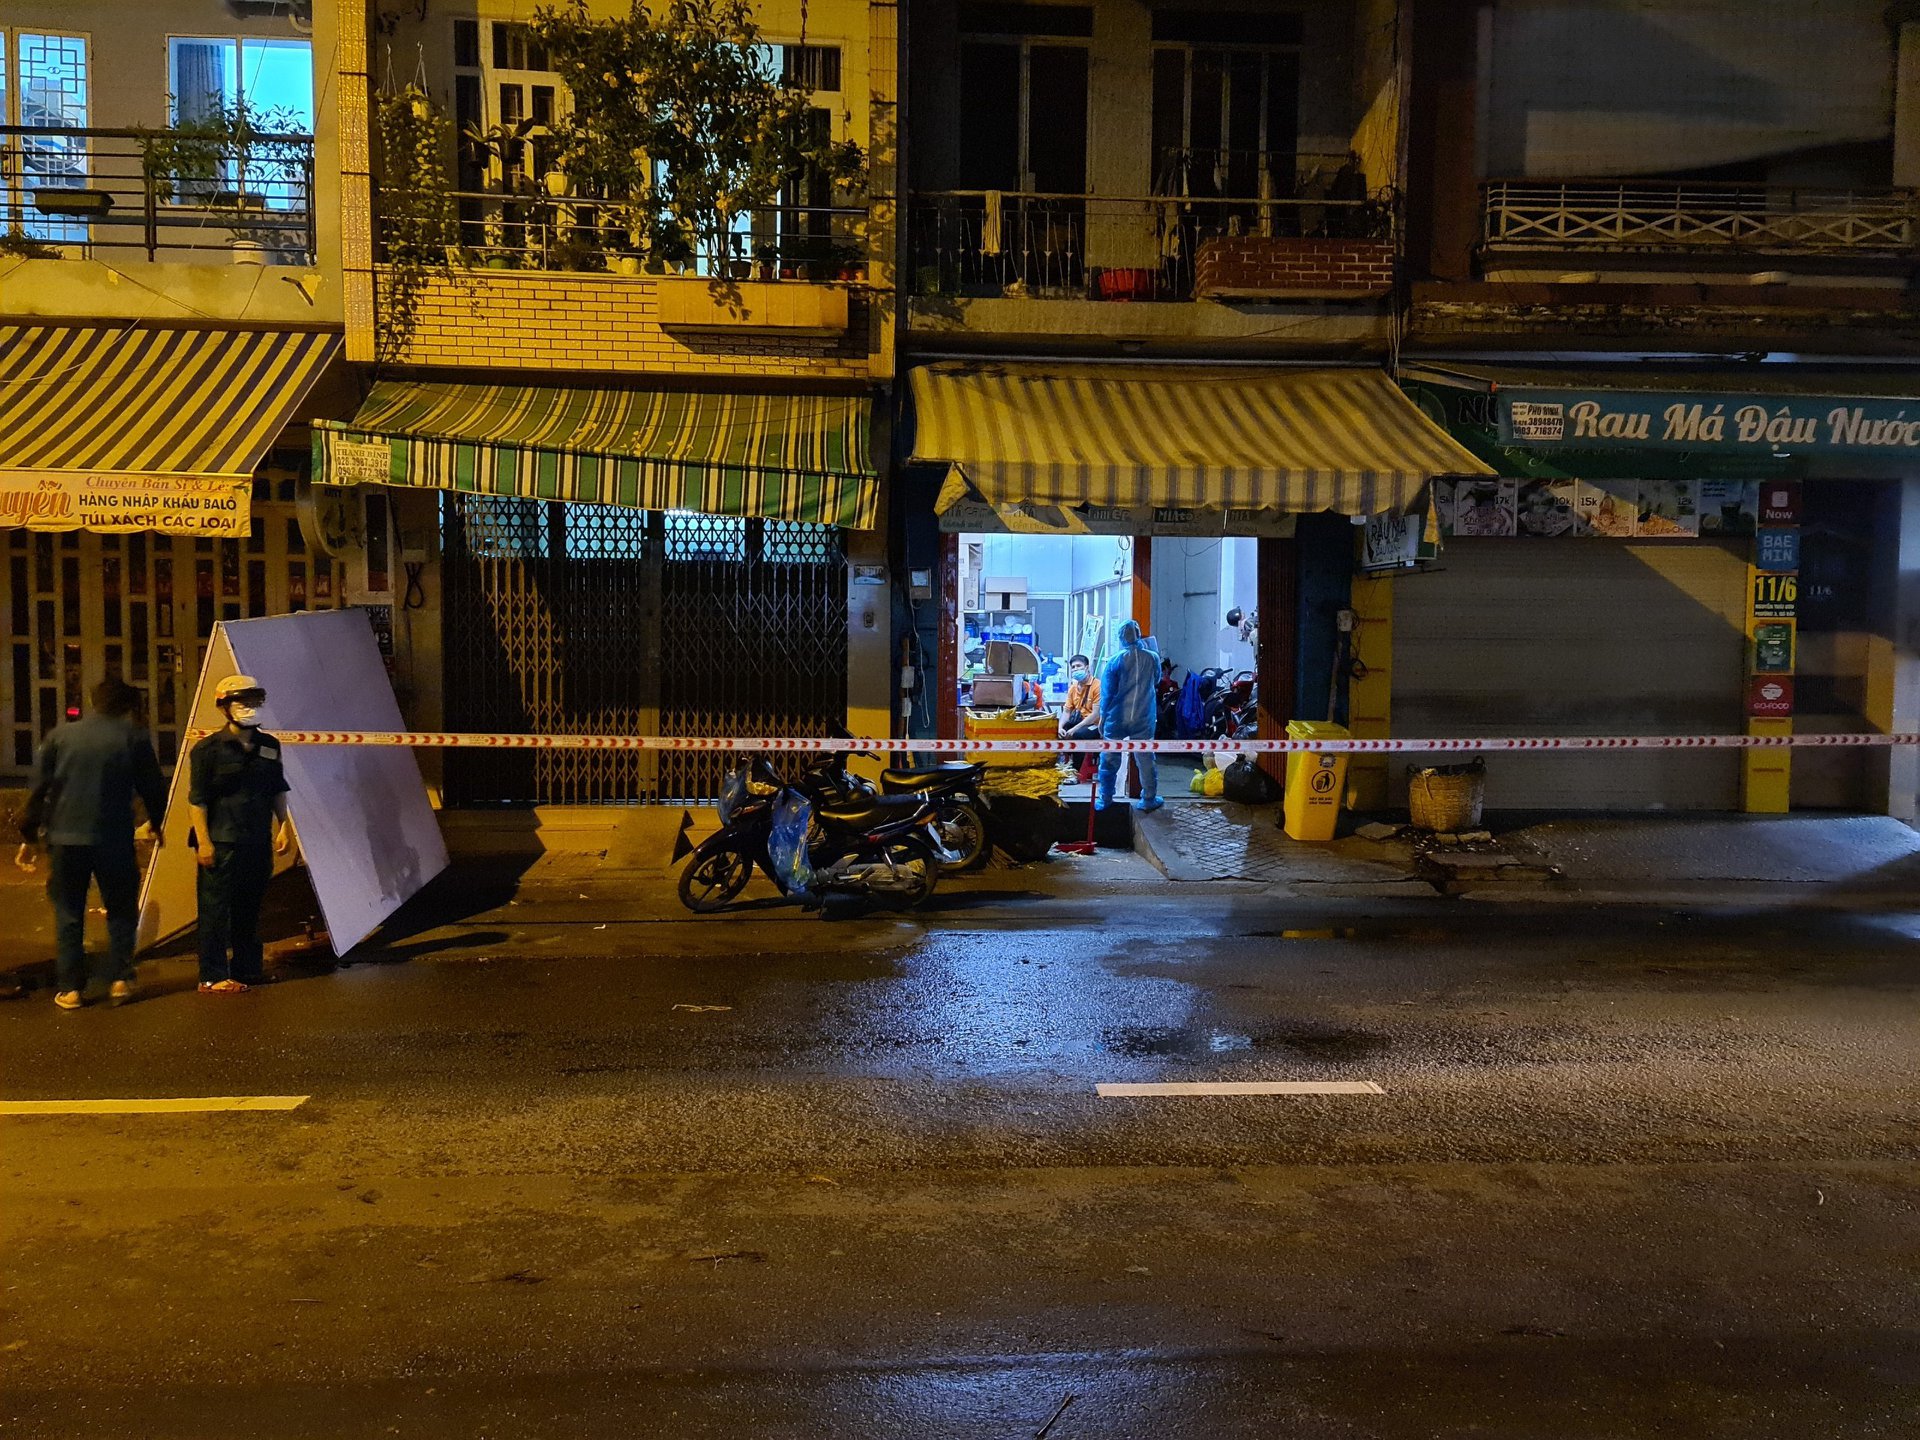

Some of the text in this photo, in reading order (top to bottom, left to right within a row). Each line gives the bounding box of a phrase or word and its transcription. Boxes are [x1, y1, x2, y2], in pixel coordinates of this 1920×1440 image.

[1569, 400, 1920, 451] Rau Má Đậu Nước
[86, 475, 137, 490] Chuyên
[142, 477, 169, 490] Bán
[192, 479, 202, 491] &
[79, 491, 118, 507] HÀNG
[123, 494, 159, 510] NHẬP
[204, 496, 237, 510] BALÔ
[1580, 497, 1598, 506] 15k
[80, 511, 236, 531] TÚI XÁCH CÁC LOẠI
[1765, 509, 1793, 519] Now
[1763, 535, 1793, 548] BAE
[1763, 549, 1793, 562] MIN
[1756, 576, 1797, 602] 11/6
